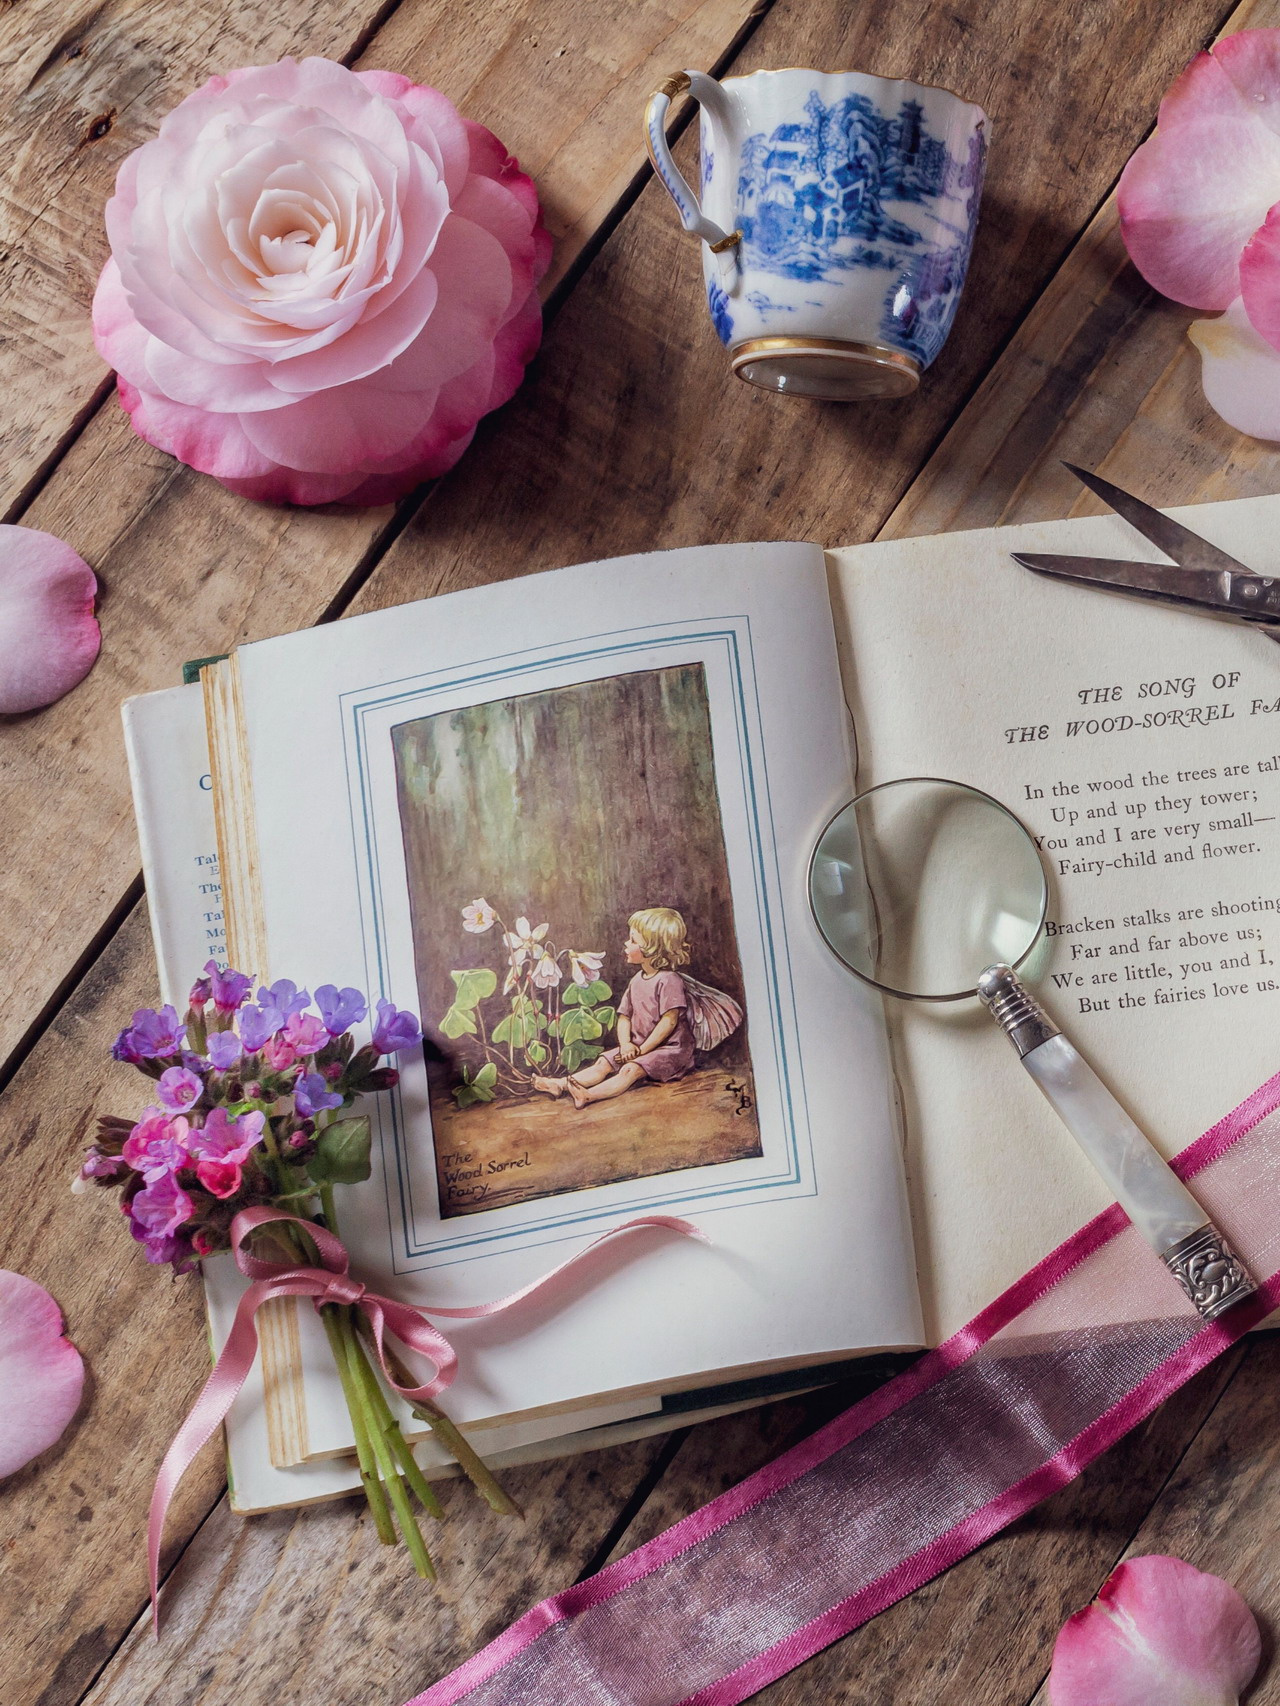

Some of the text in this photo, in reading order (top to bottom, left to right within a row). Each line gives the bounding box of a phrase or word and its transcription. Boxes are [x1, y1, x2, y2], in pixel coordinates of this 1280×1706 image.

[1078, 672, 1241, 705] THE SONG OF
[1004, 725, 1049, 744] THE
[1066, 704, 1234, 737] WOOD-SORREL
[1024, 785, 1044, 800] In
[1052, 781, 1080, 796] the
[1087, 773, 1134, 792] wood
[1142, 771, 1169, 786] the
[1177, 768, 1217, 782] trees
[1224, 765, 1250, 777] are
[1050, 791, 1257, 826] Up and up they tower;
[1034, 835, 1068, 851] You
[1076, 829, 1106, 846] and
[1113, 827, 1122, 842] I
[1131, 829, 1156, 841] are
[1163, 823, 1200, 839] very
[195, 854, 220, 866] Tal
[1058, 843, 1260, 876] Fairy-child and flower.
[1044, 915, 1115, 937] Bracken
[1123, 909, 1171, 927] stalks
[1178, 909, 1204, 921] are
[1070, 929, 1262, 960] Far and far above us;
[1051, 949, 1273, 989] We are little, you and I,
[1078, 980, 1279, 1013] But the fairies love us.
[442, 1152, 473, 1167] The
[444, 1152, 531, 1183] Wood Sorrel
